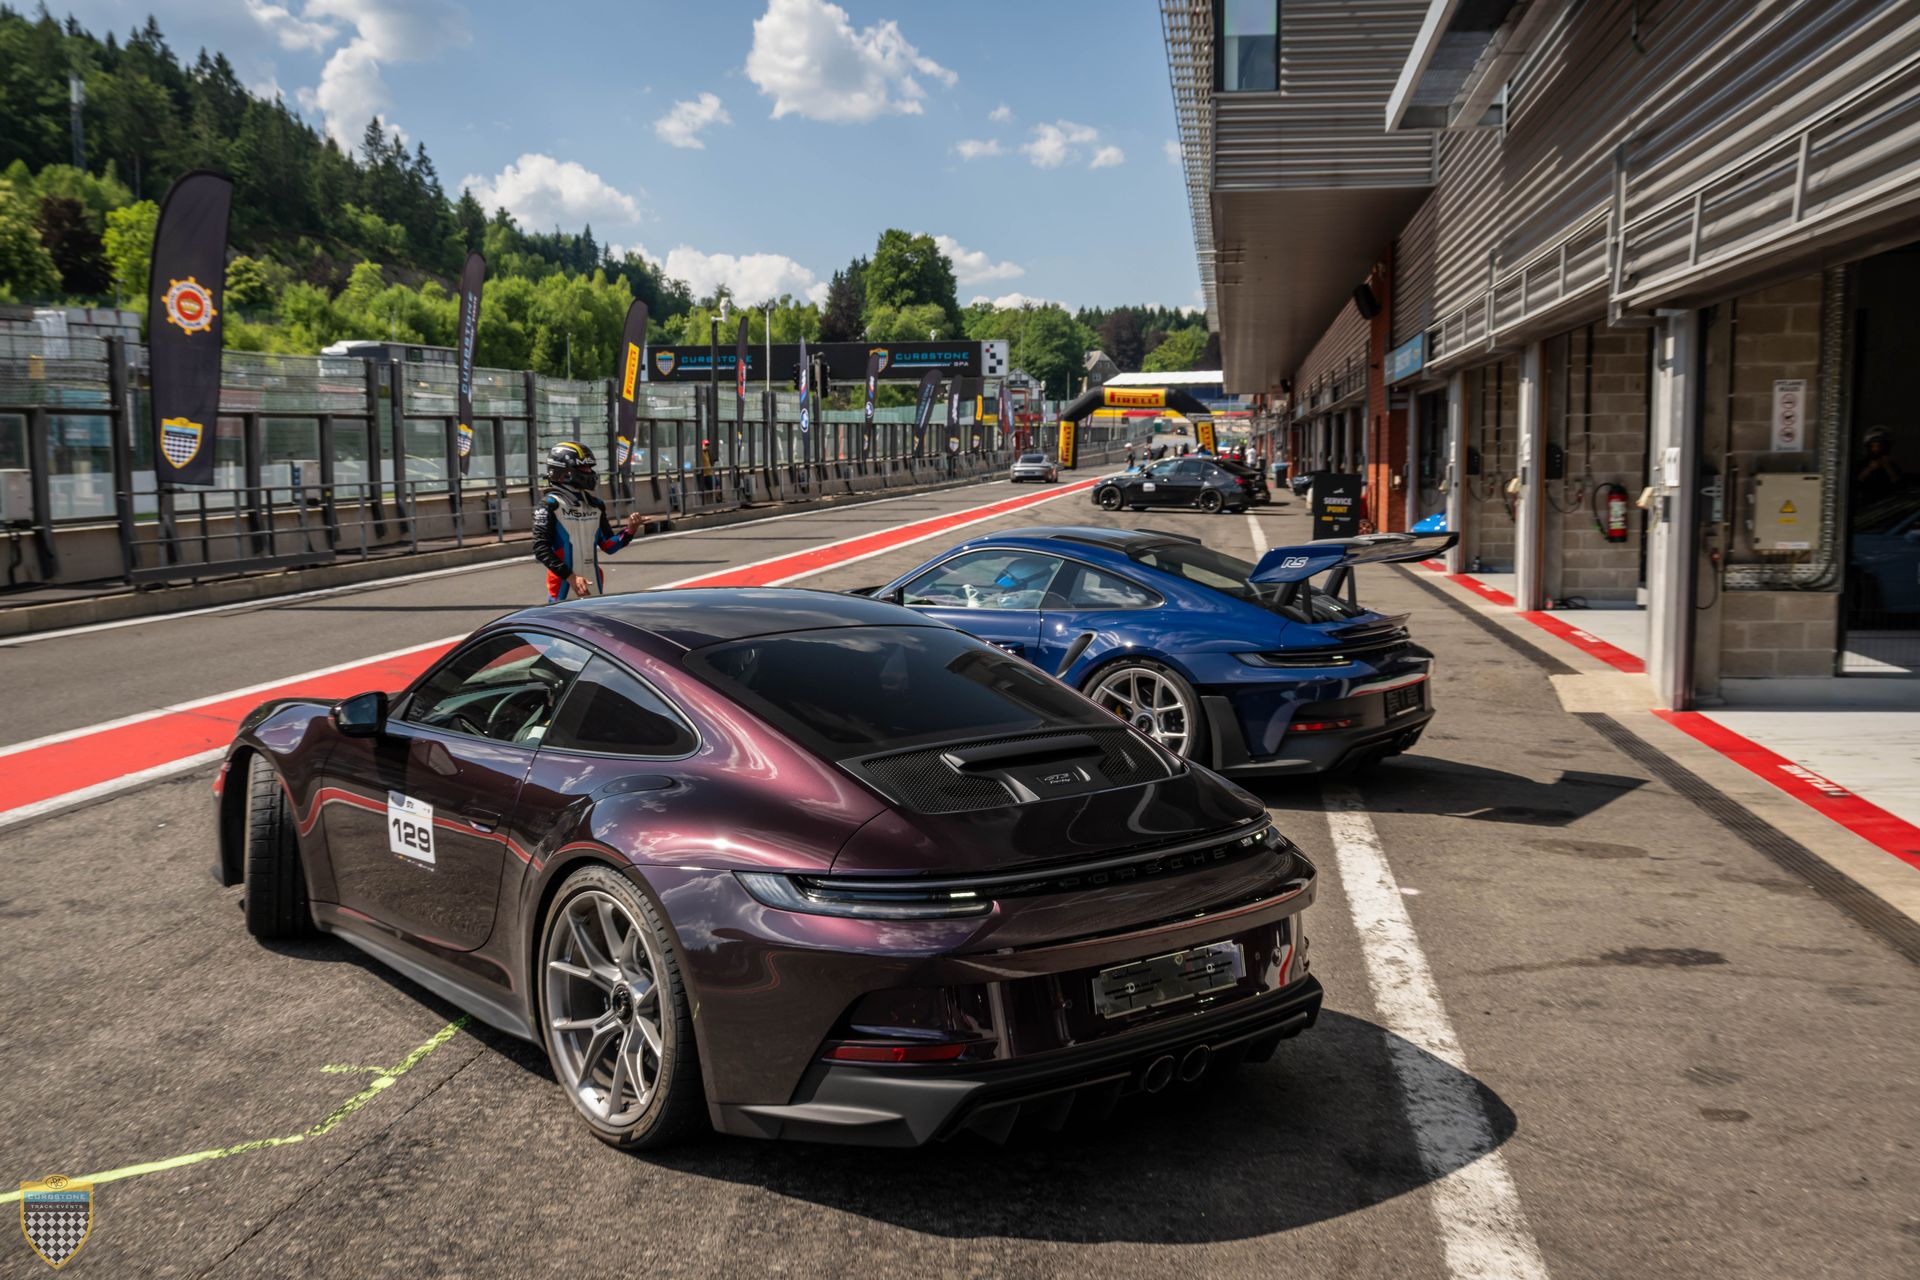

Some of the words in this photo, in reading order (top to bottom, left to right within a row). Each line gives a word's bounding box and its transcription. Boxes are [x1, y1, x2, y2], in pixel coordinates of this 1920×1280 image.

[461, 290, 474, 395] CURBSTONE
[681, 355, 752, 364] CURBTOE
[895, 352, 969, 360] CURBSTONE
[625, 349, 638, 396] PIRELLI
[1110, 391, 1159, 405] PIRELLI
[1323, 497, 1353, 505] SERVICE
[1327, 505, 1348, 513] POINT
[1280, 556, 1309, 569] RS
[392, 817, 431, 854] 129
[1060, 846, 1228, 889] PORSCHE
